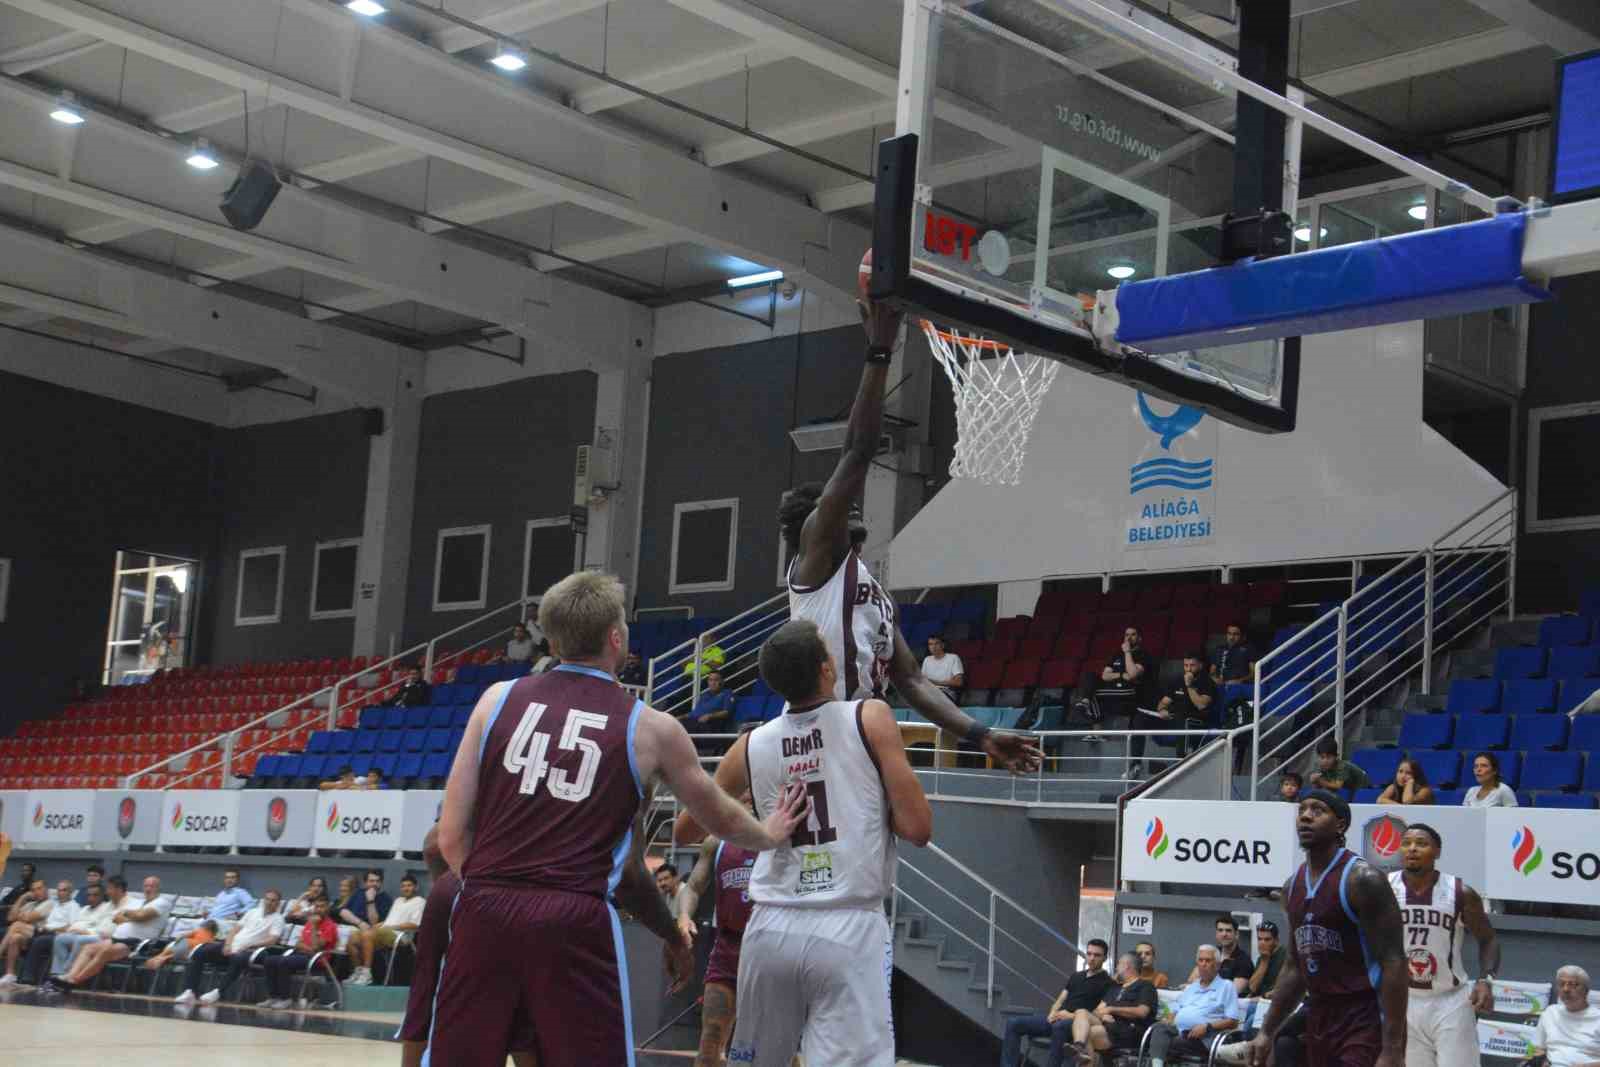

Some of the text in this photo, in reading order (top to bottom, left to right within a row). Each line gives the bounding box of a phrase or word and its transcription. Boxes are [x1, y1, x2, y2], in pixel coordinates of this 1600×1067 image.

[1142, 497, 1199, 518] ALİAĞA
[1128, 516, 1211, 543] BELEDİYESİ
[503, 702, 608, 802] 45
[44, 814, 84, 830] SOCAR
[185, 815, 228, 832] SOCAR
[341, 816, 391, 835] SOCAR
[1174, 838, 1271, 865] SOCAR
[1127, 915, 1149, 927] VIP
[1408, 927, 1430, 946] 77
